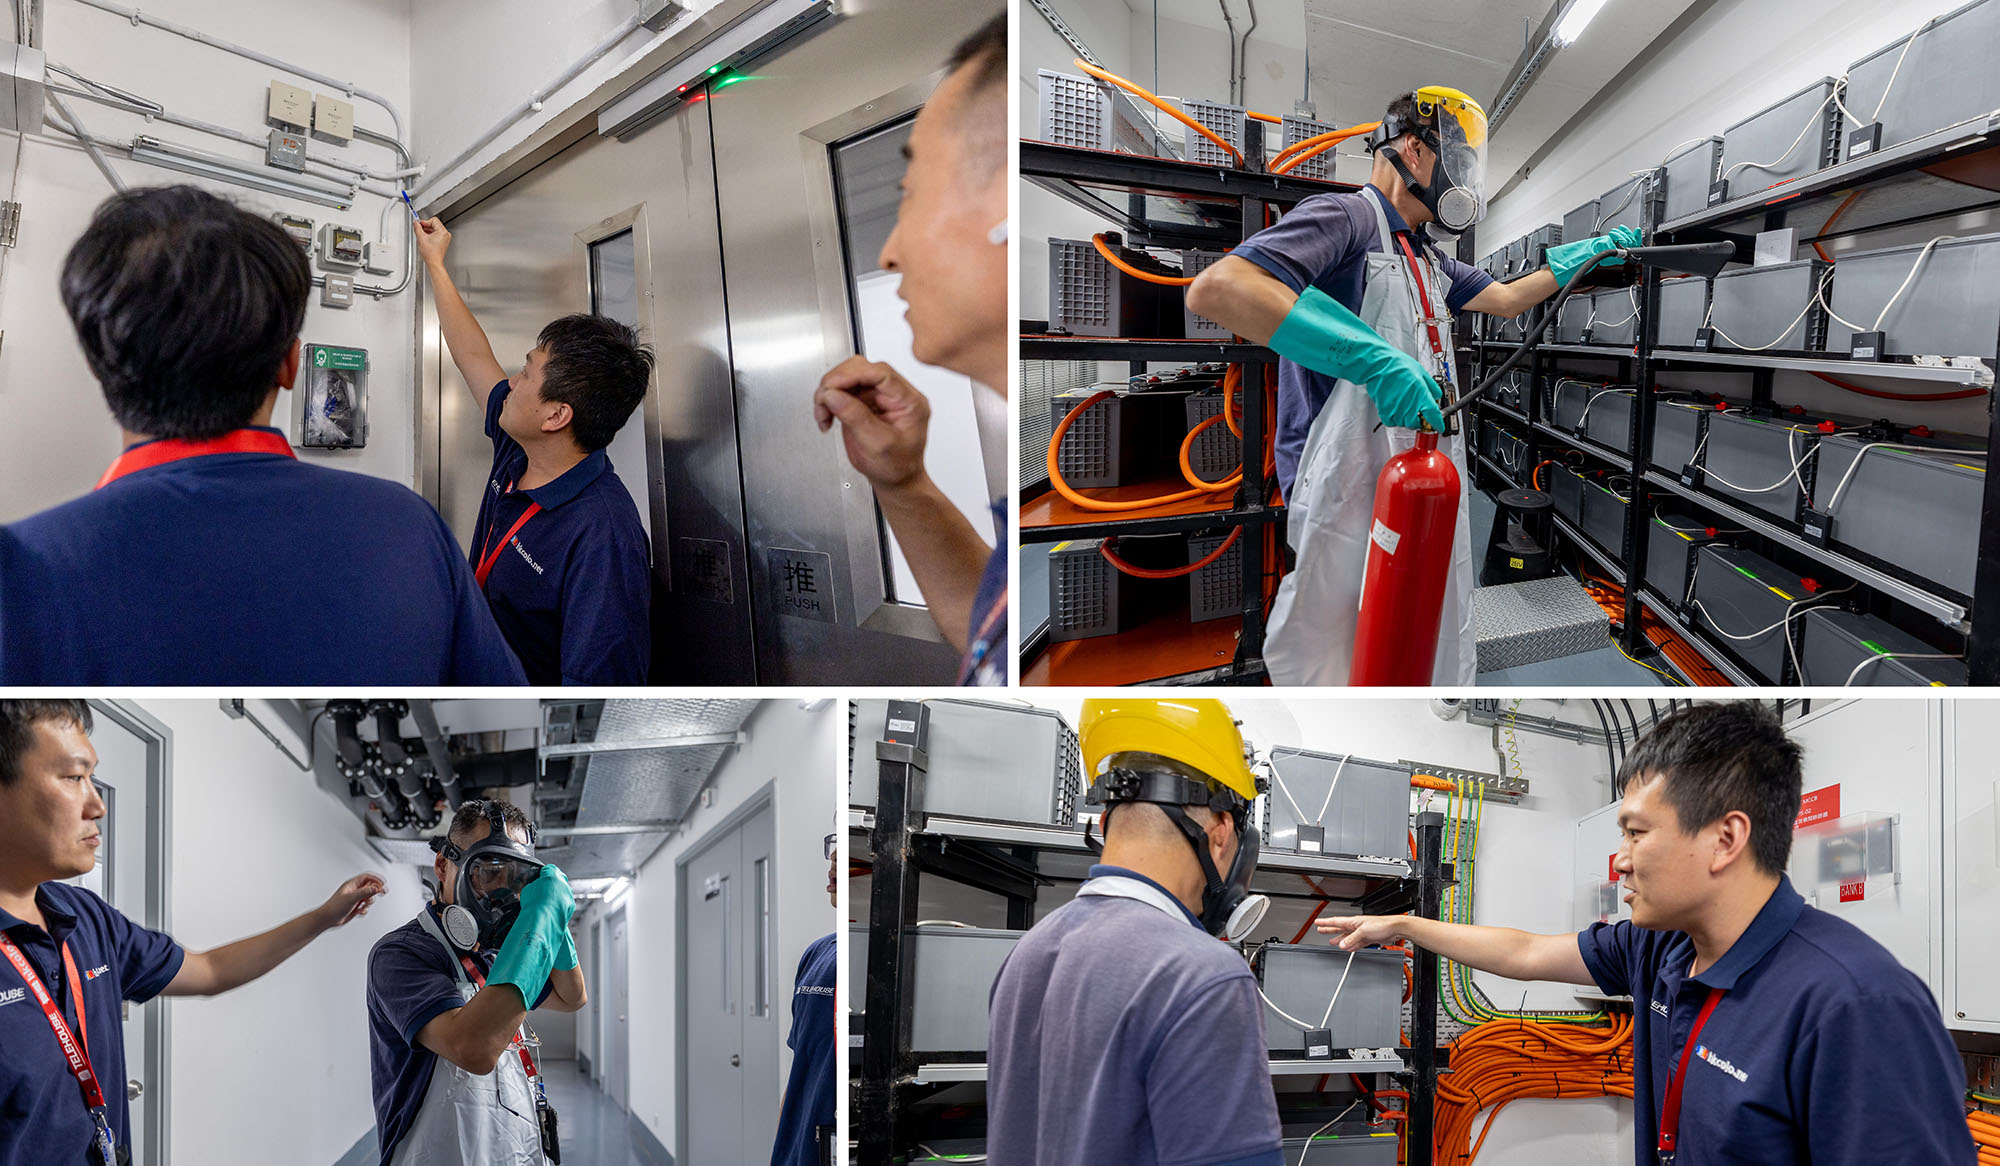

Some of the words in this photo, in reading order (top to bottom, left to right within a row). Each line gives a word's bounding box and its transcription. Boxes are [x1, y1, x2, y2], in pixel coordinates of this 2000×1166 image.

[783, 559, 817, 594] 推
[785, 595, 821, 612] PUSH
[1841, 884, 1857, 897] BANK
[1858, 882, 1864, 895] B
[48, 1012, 84, 1070] TELEHOUSE
